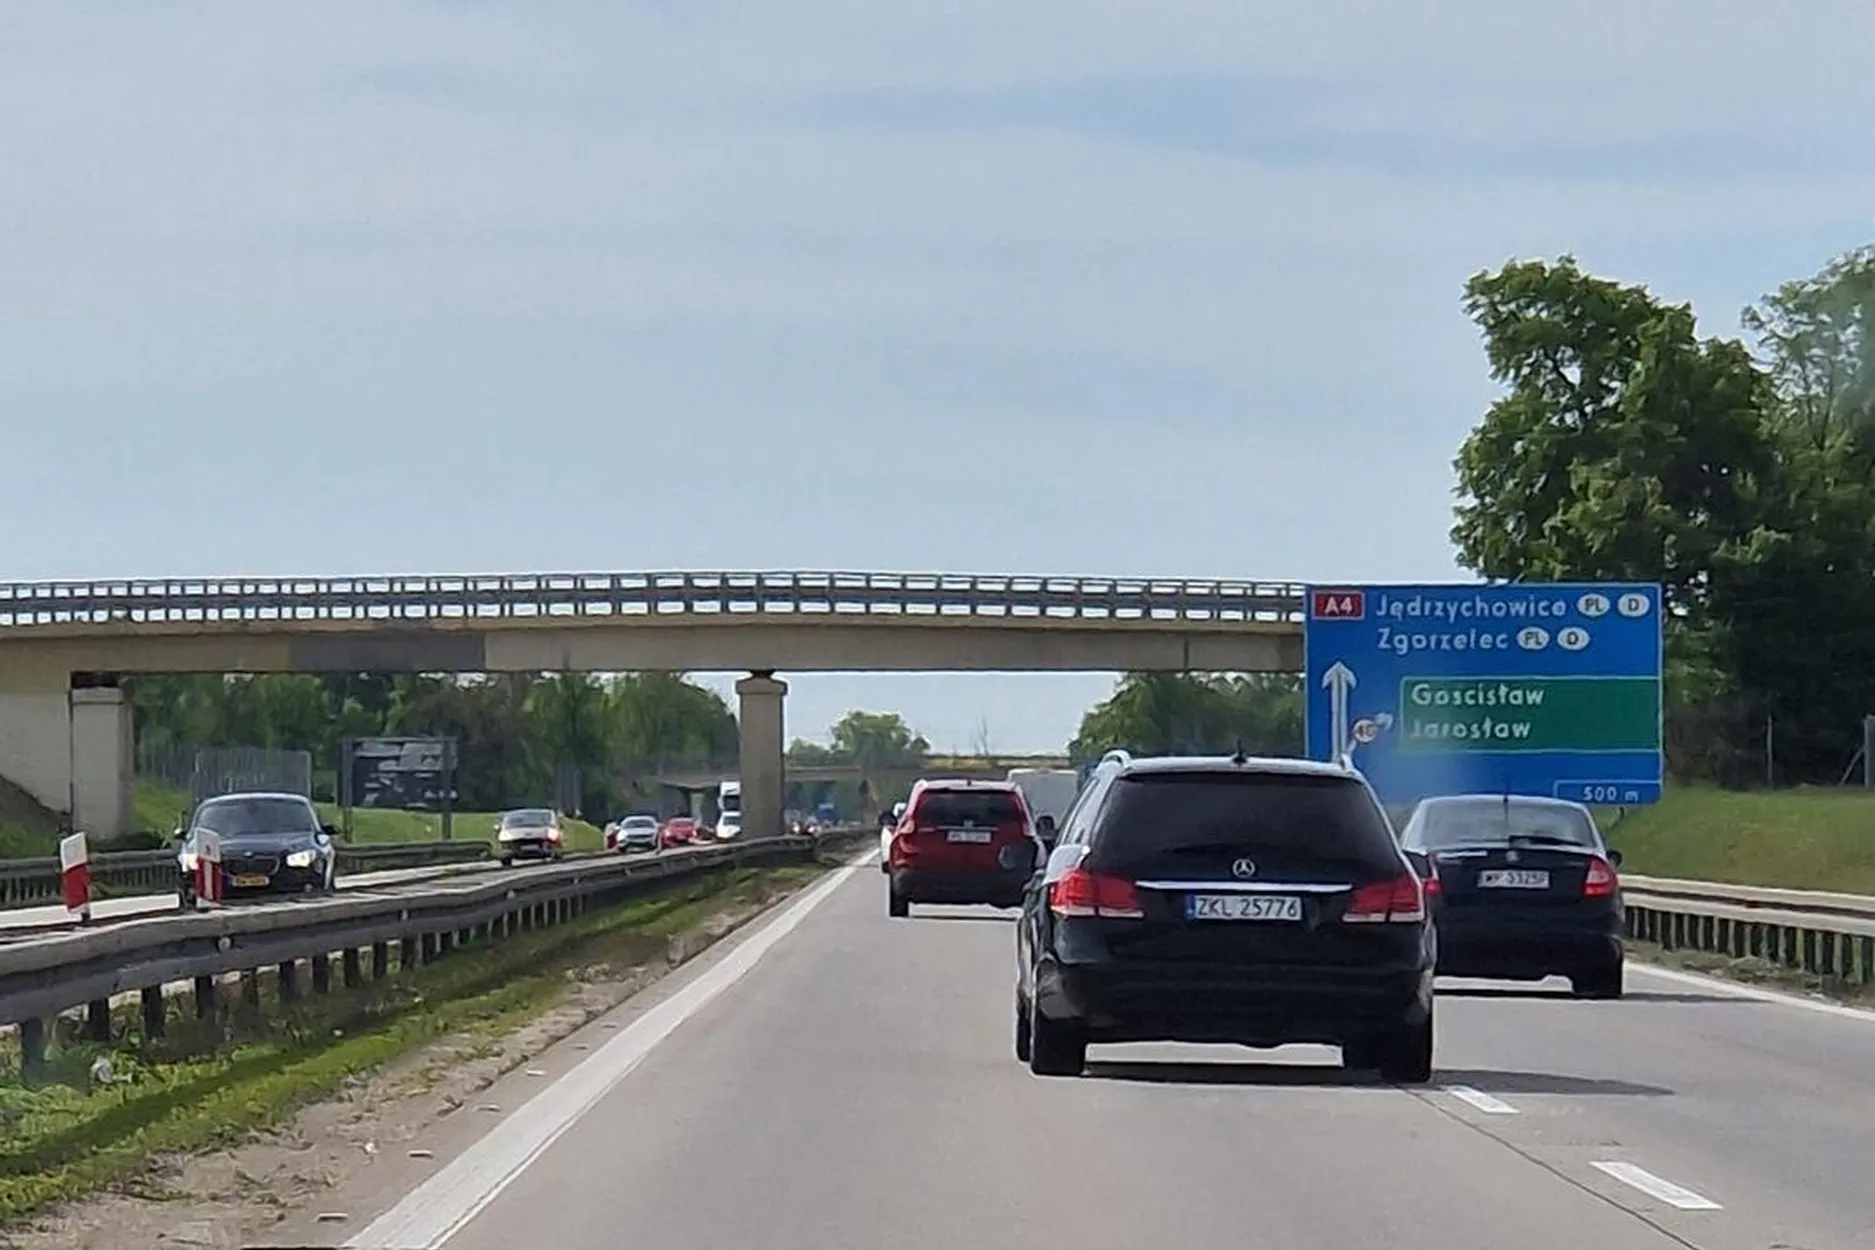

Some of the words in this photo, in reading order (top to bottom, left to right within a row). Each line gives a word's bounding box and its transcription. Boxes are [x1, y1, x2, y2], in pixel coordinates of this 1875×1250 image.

[1324, 596, 1353, 615] A4
[1376, 594, 1567, 624] Jędrzychowice
[1585, 597, 1604, 612] PL
[1627, 598, 1640, 612] D
[1377, 627, 1509, 655] Zgorzelec
[1525, 631, 1543, 646] PL
[1582, 786, 1617, 801] 500
[1624, 791, 1639, 802] m
[1198, 898, 1232, 916] ZKL
[1241, 899, 1297, 917] 25776
